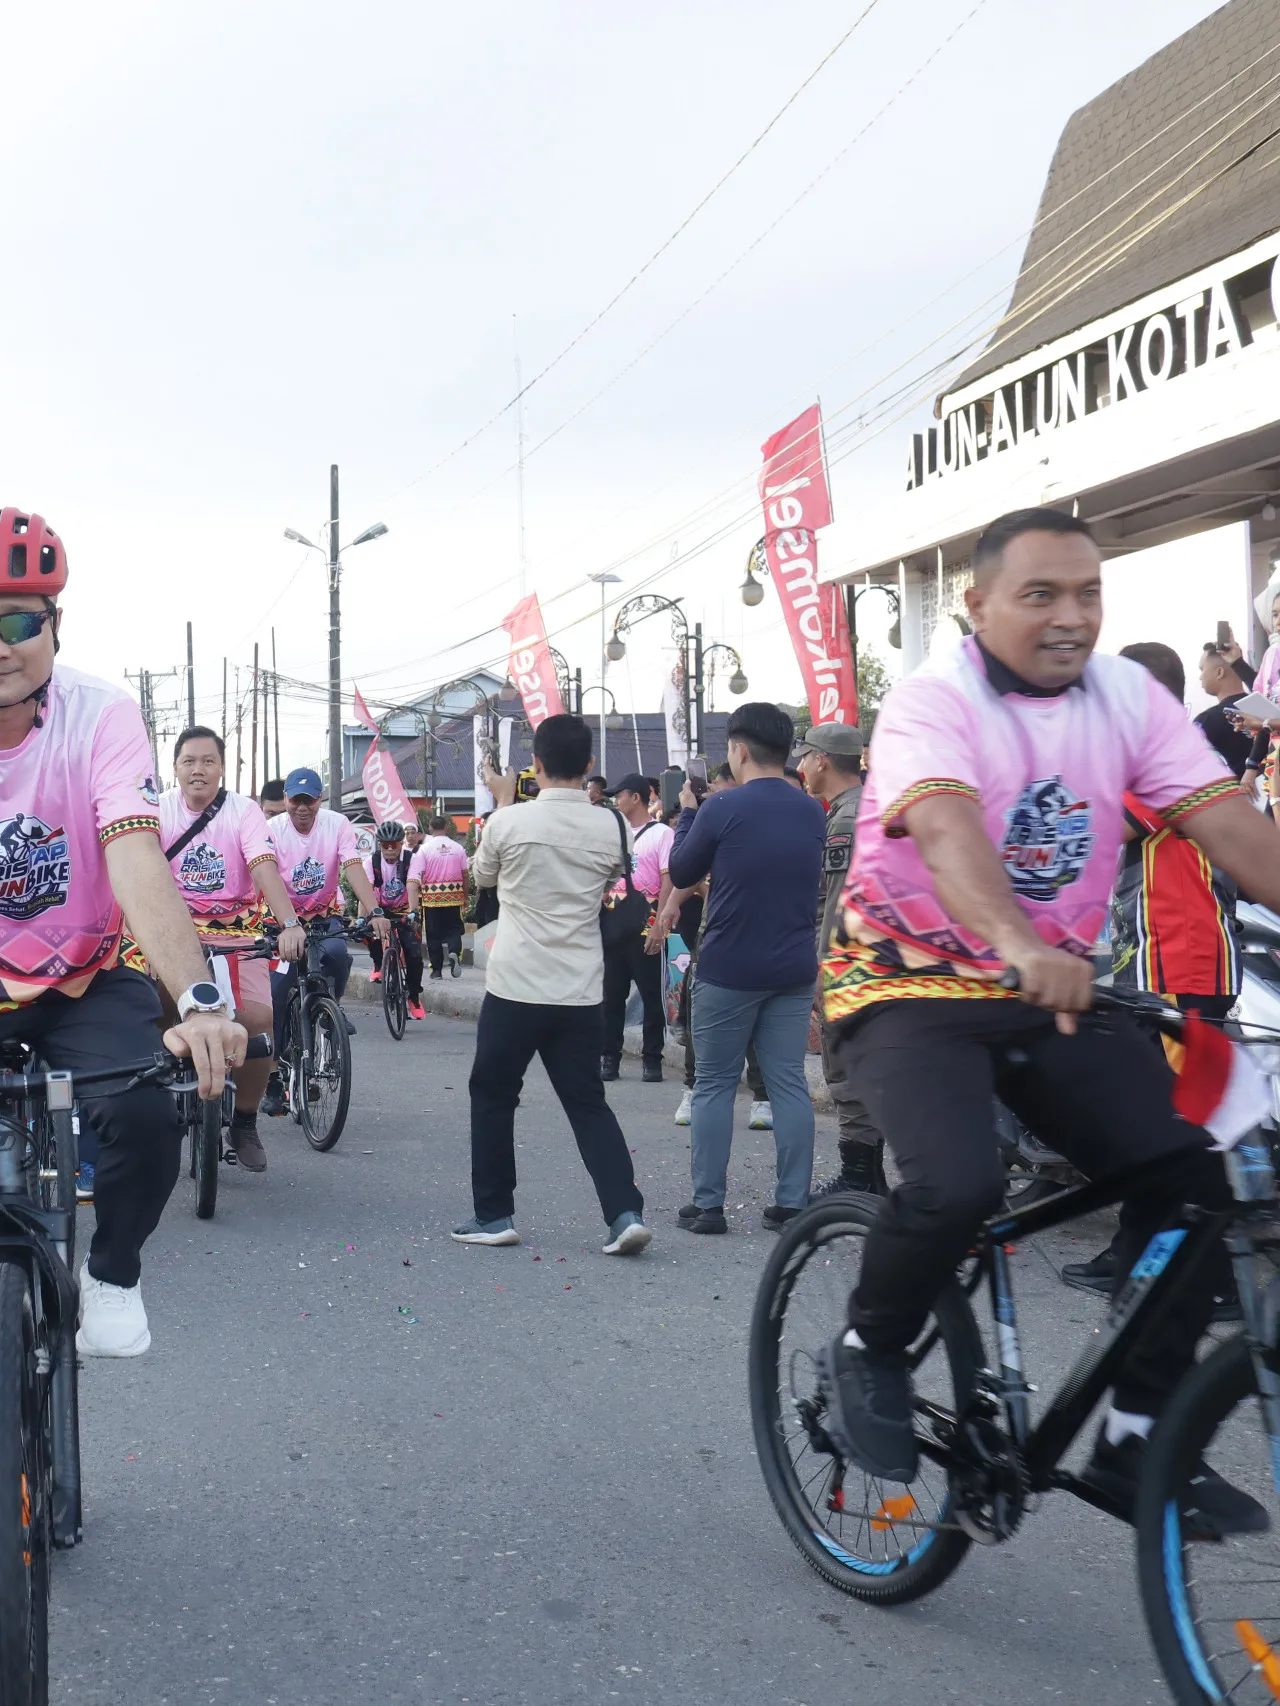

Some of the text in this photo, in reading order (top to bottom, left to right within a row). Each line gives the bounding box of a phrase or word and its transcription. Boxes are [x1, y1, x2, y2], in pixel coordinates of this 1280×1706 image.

[906, 352, 1087, 491] ALUN-ALUN
[1107, 280, 1247, 402] KOTA
[28, 842, 67, 867] TAP
[25, 861, 70, 893] BIKE
[181, 864, 208, 873] QRIS
[183, 869, 226, 881] FUN BIKE
